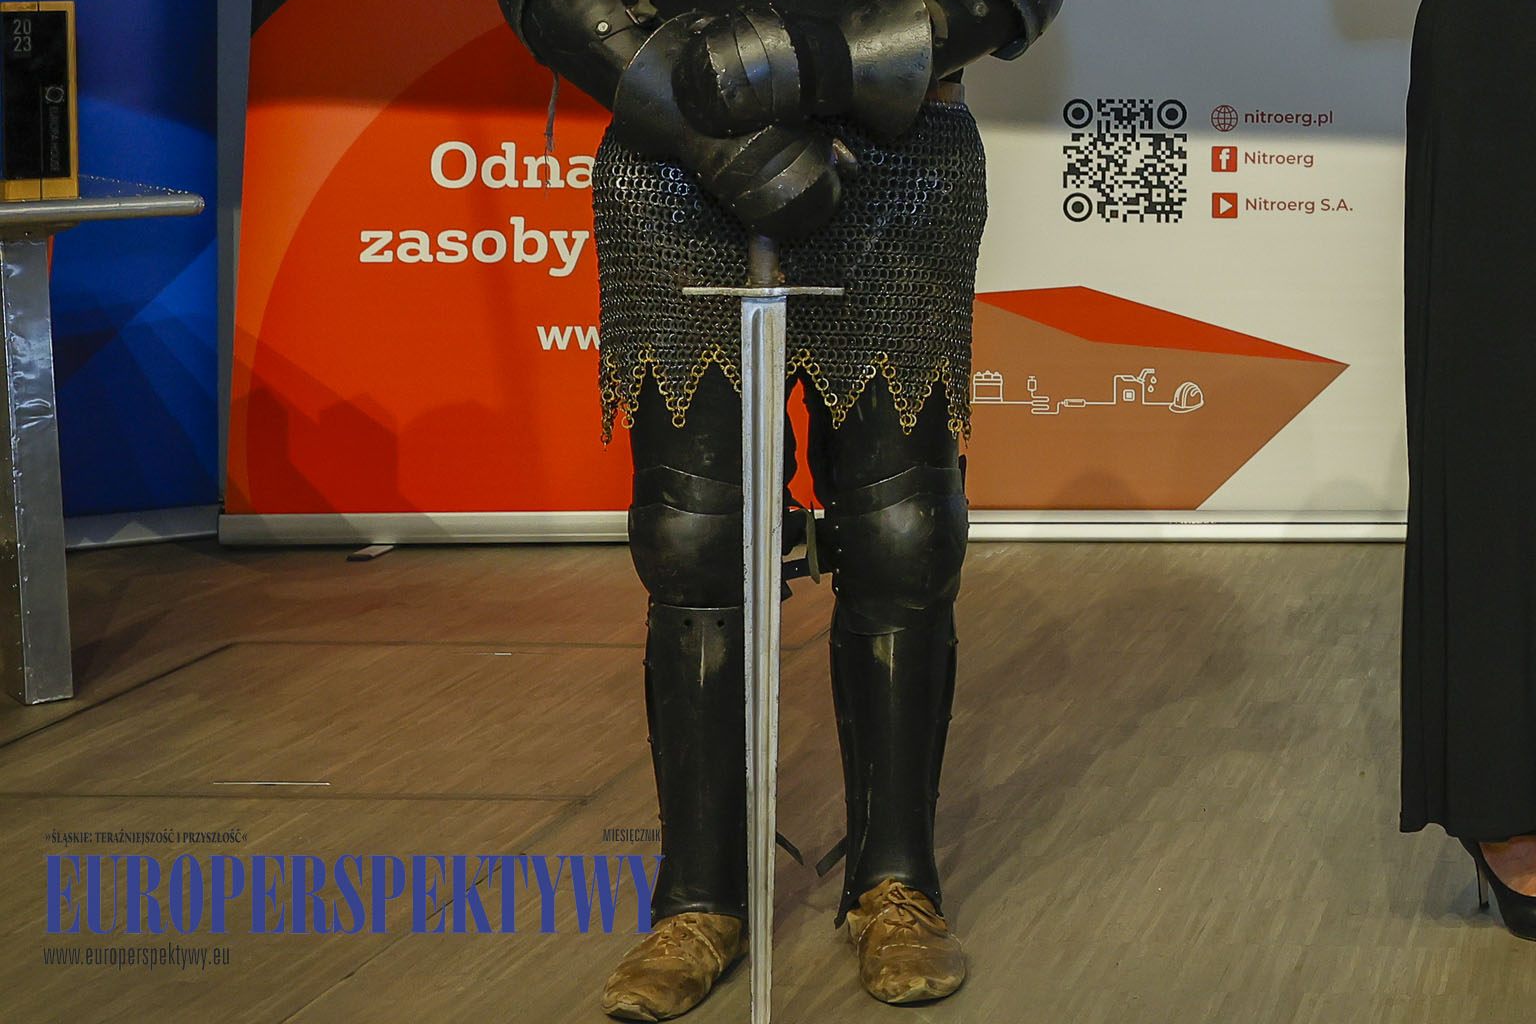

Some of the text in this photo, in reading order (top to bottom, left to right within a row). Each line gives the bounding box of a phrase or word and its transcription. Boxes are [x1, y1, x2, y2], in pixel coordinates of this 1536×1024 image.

[13, 19, 32, 35] 20
[13, 36, 32, 53] 23
[1244, 110, 1333, 126] nitroerg.pl
[1244, 152, 1314, 167] Nitroerg
[1245, 198, 1353, 214] Nitroerg S.A.
[358, 215, 591, 278] zasoby
